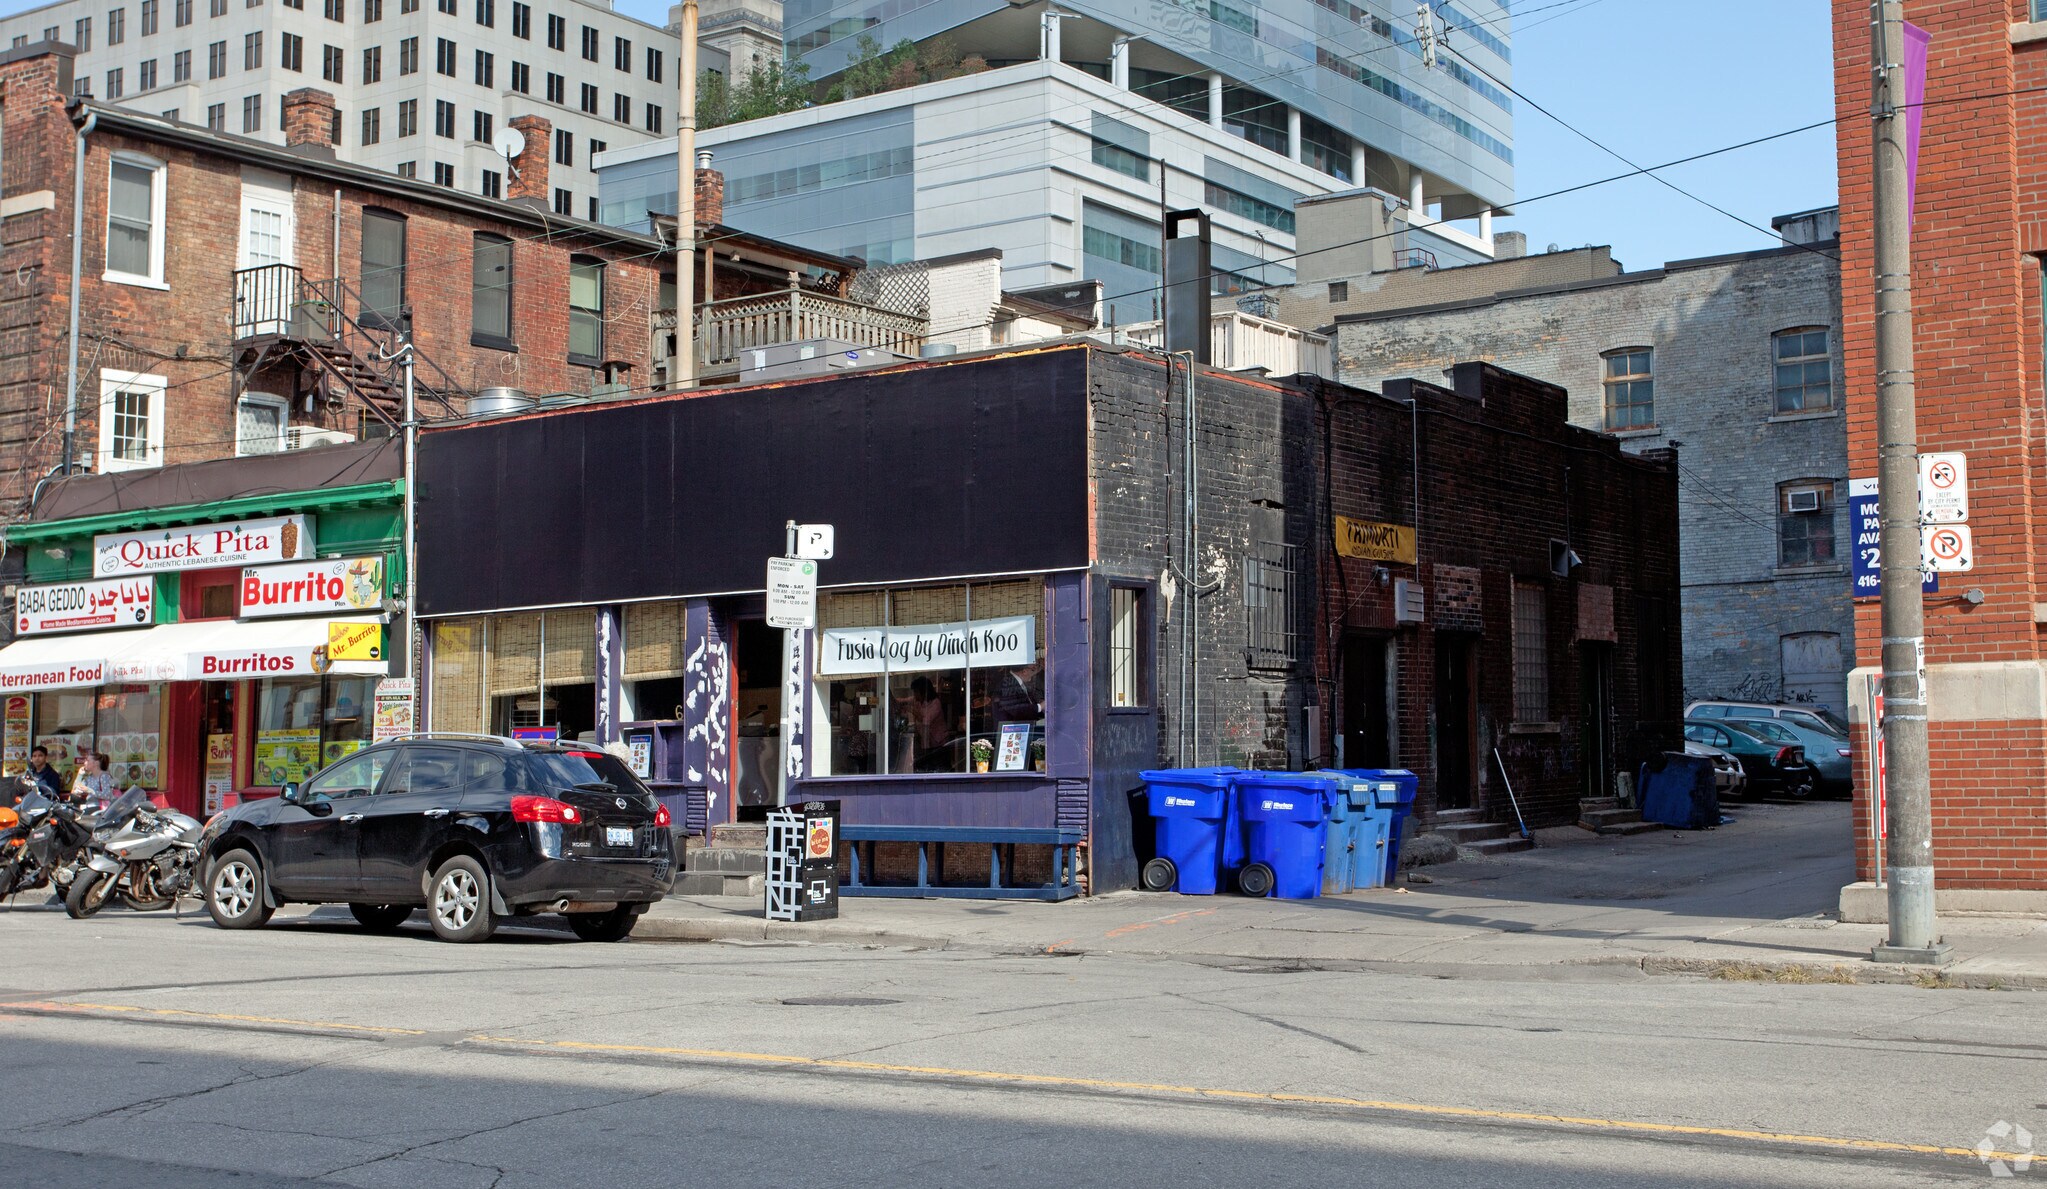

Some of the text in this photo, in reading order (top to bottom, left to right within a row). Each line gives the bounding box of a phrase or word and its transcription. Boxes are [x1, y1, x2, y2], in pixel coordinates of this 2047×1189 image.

[1346, 521, 1399, 549] TRIMURTI
[121, 533, 202, 568] Quick
[213, 530, 270, 554] Pita
[1352, 545, 1395, 559] INDIAN CUISINE
[144, 553, 247, 569] AUTHENTIC LEBANESE CUISINE
[244, 569, 259, 577] Mr.
[243, 571, 344, 607] Burrito
[20, 586, 86, 614] BABA GEDDO
[66, 618, 96, 627] Mediterranean
[347, 625, 376, 647] Burrito
[838, 637, 875, 661] Fusia
[914, 635, 933, 662] by
[983, 629, 1018, 653] Koo
[202, 653, 295, 674] Burritos
[0, 663, 102, 687] terranean Food
[399, 680, 411, 688] Pita
[376, 702, 383, 715] 2
[674, 704, 684, 720] 6
